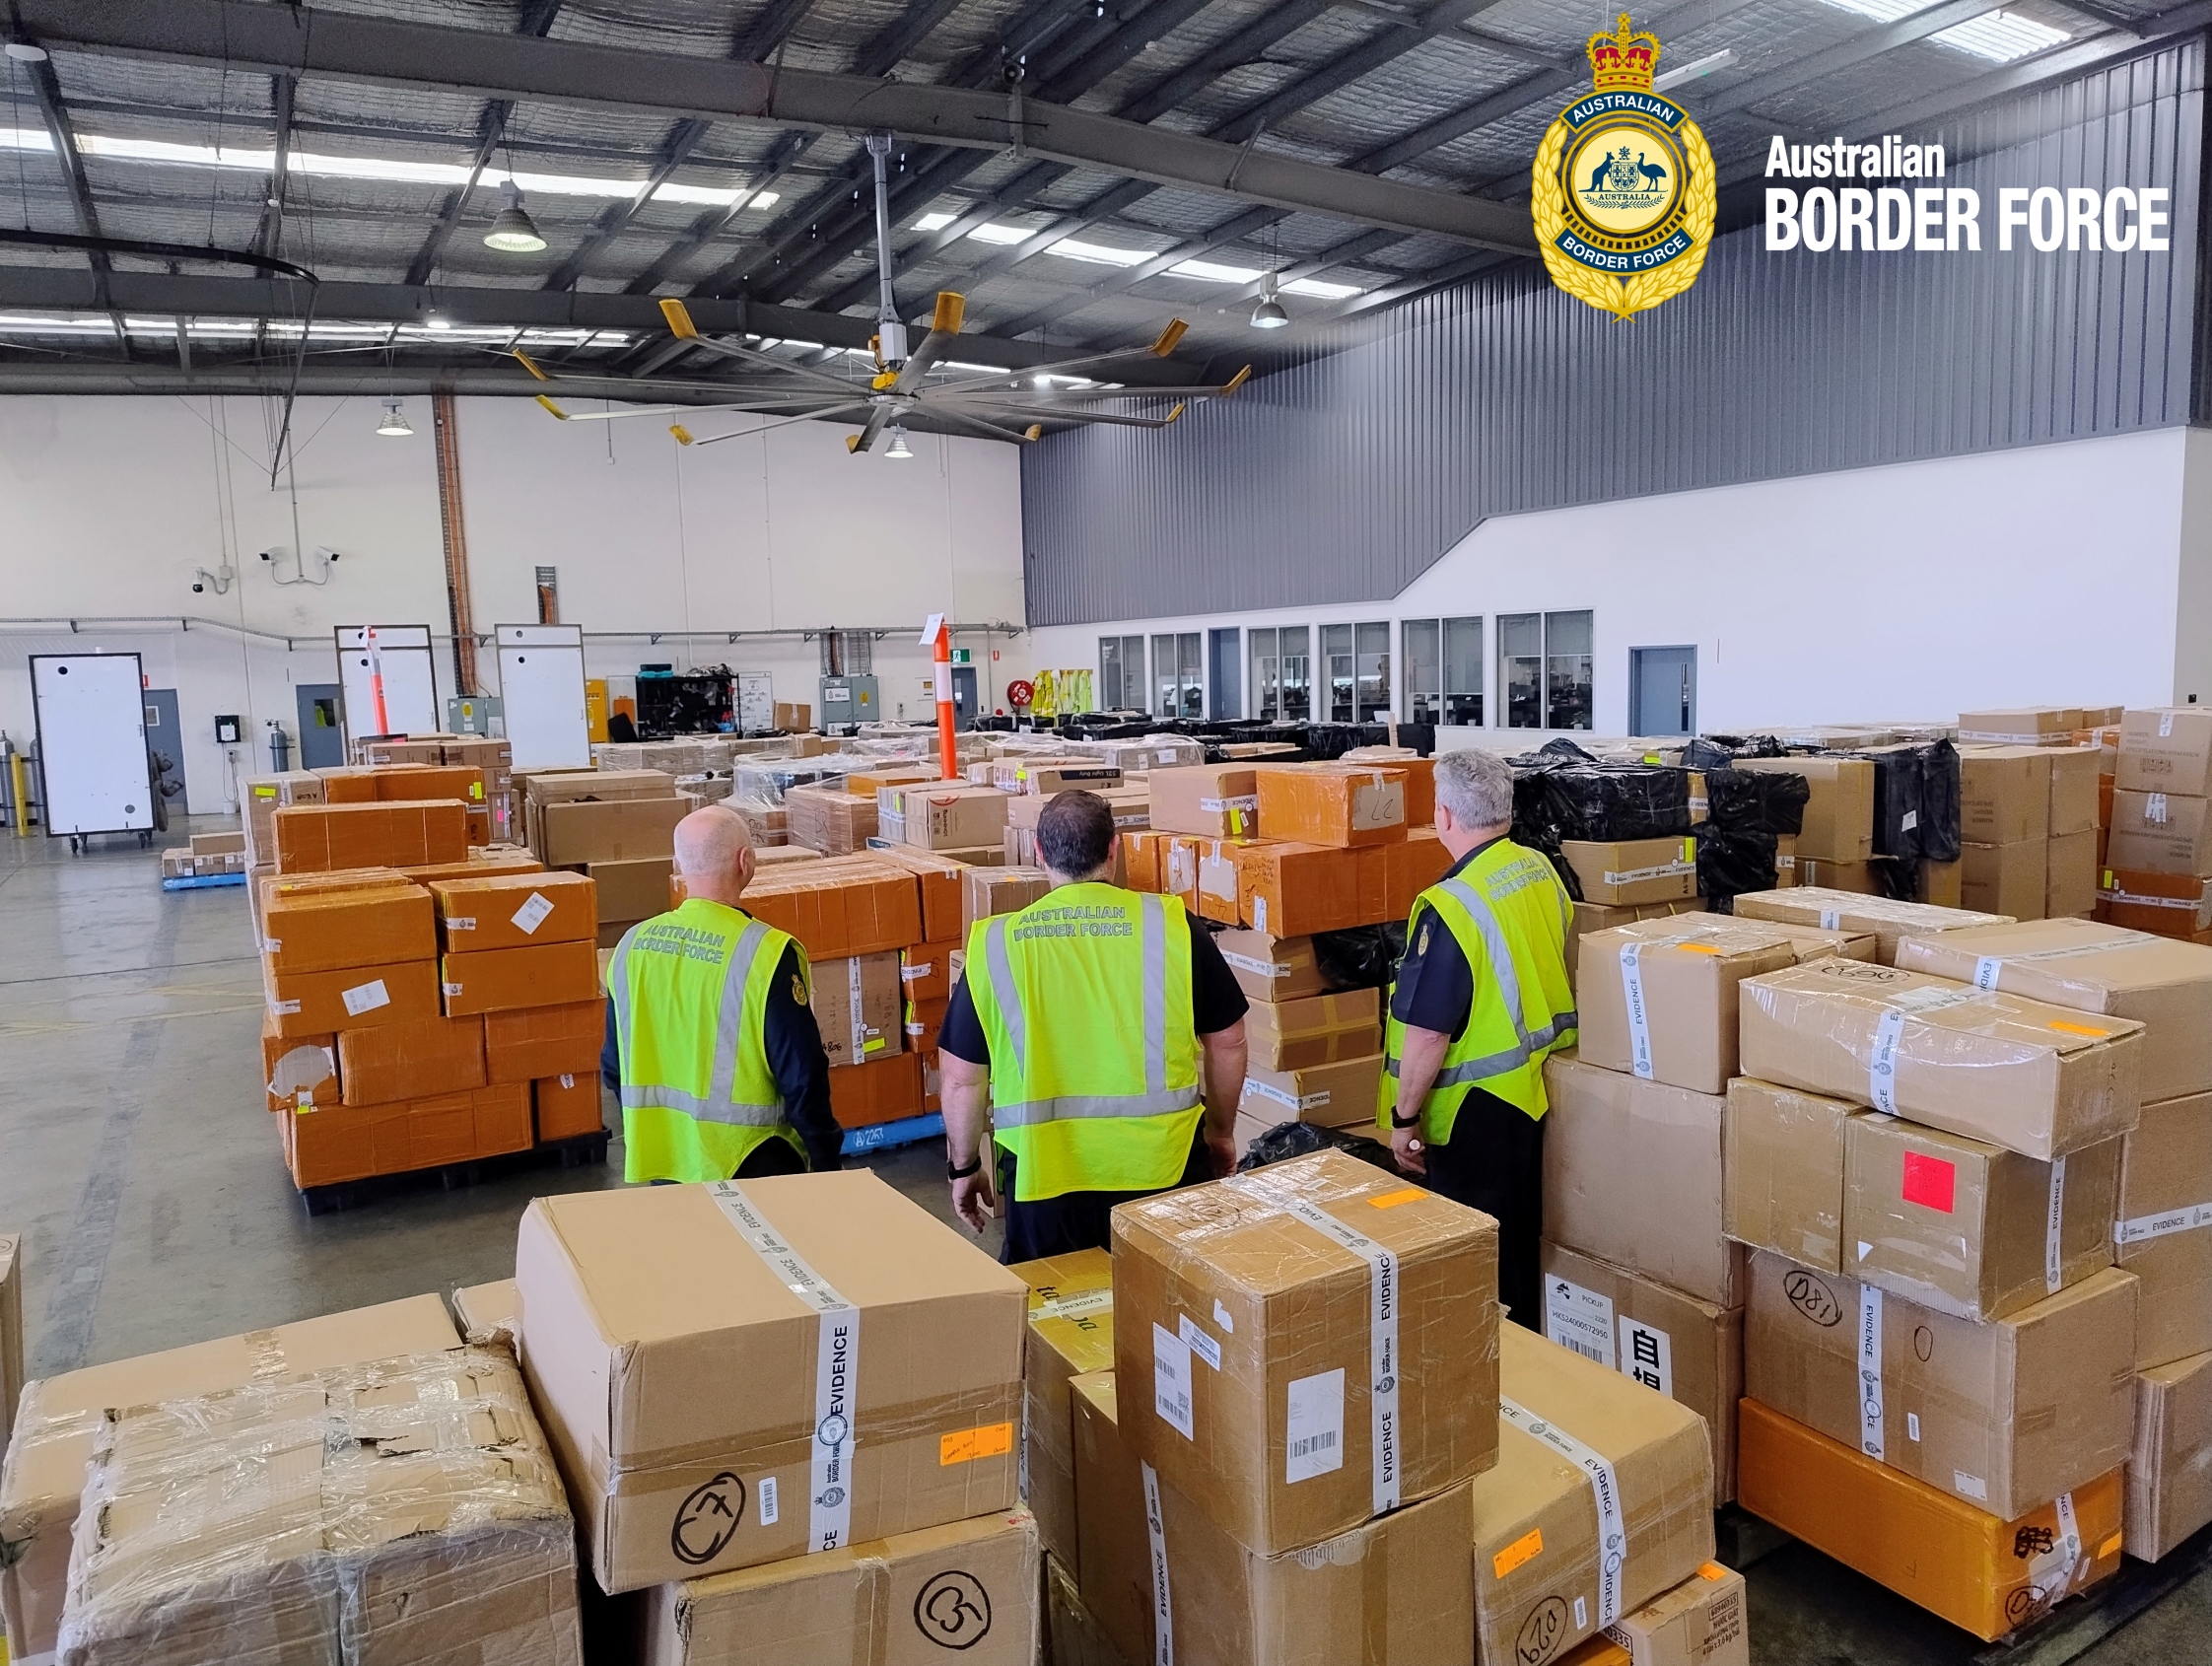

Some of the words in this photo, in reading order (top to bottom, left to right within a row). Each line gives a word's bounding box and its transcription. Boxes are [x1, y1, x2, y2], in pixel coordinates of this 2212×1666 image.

[1485, 857, 1540, 887] AUSTRALIA
[1018, 906, 1126, 925] AUSTRALIAN
[643, 925, 726, 947] AUSTRALIAN
[1013, 924, 1076, 941] BORDER
[1080, 923, 1133, 936] FORCE
[633, 937, 681, 956] BORDER
[682, 943, 725, 964] FORCE
[1630, 979, 1643, 1024] EVIDENCE
[731, 1203, 761, 1228] EVIDENCE
[2052, 1176, 2061, 1229] EVIDENCE
[2152, 1217, 2185, 1231] EVIDENCE
[780, 1258, 815, 1286] EVIDENCE
[1375, 1251, 1391, 1321] EVIDENCE
[1050, 1297, 1103, 1313] EVIDENCE
[1581, 1294, 1604, 1308] PICKUP
[1594, 1314, 1608, 1325] 2220
[1864, 1304, 1874, 1358] EVIDENCE
[830, 1326, 848, 1417] EVIDENCE
[1382, 1411, 1393, 1484] EVIDENCE
[831, 1458, 840, 1483] BORDER
[1584, 1458, 1614, 1519] EVIDENCE
[1154, 1549, 1167, 1618] EVIDENCE
